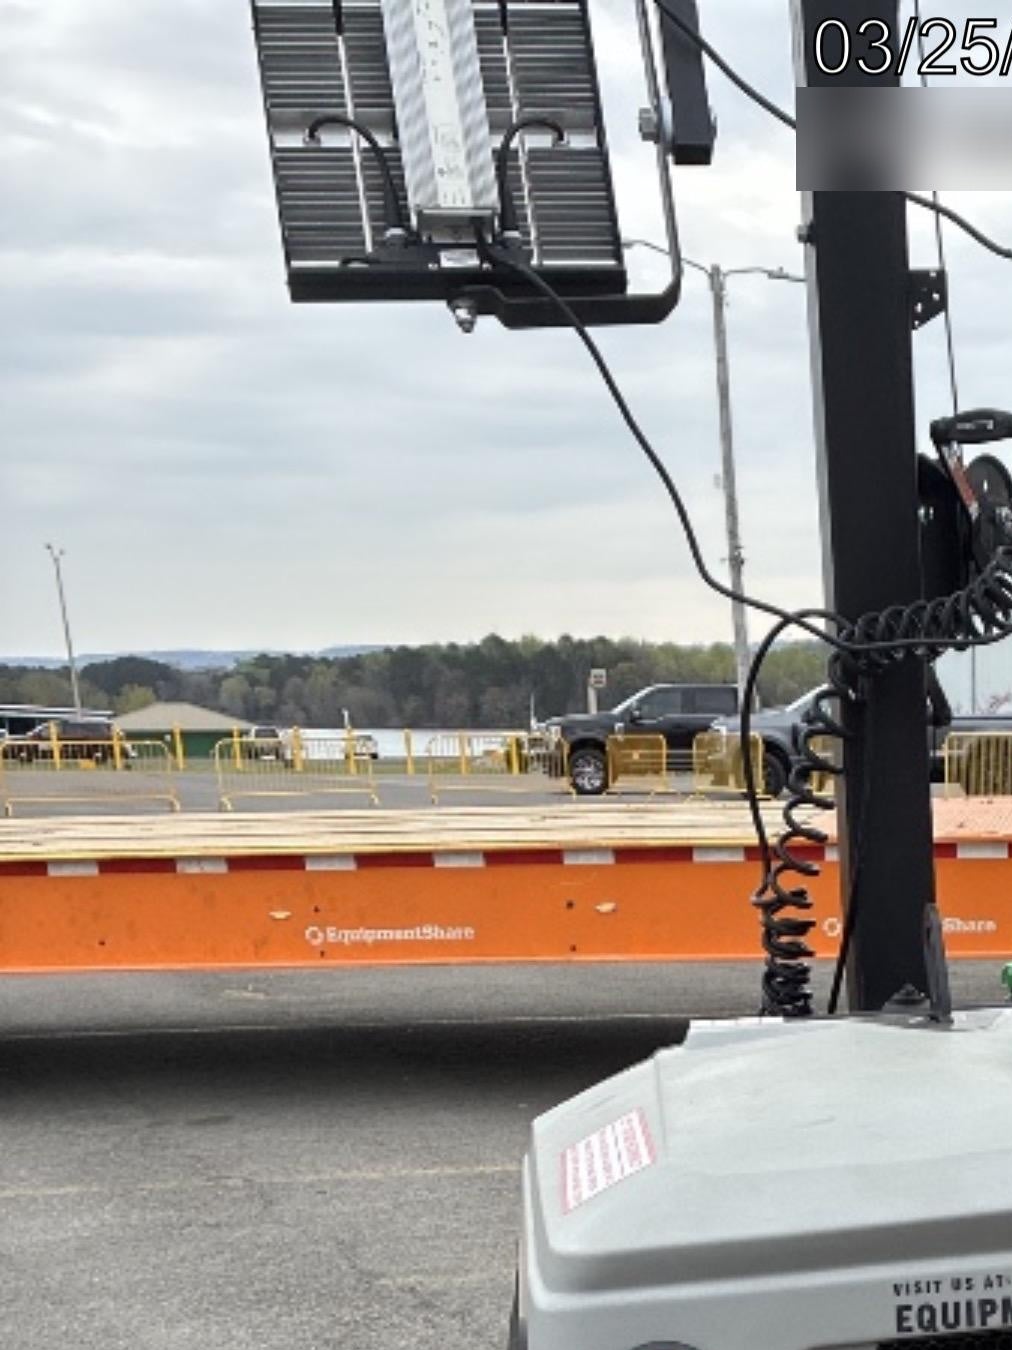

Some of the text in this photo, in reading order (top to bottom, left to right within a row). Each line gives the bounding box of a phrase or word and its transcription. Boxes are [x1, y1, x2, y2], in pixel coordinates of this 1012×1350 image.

[325, 926, 475, 945] EquipmentShare
[893, 1279, 943, 1297] VISIT
[951, 1277, 975, 1292] US
